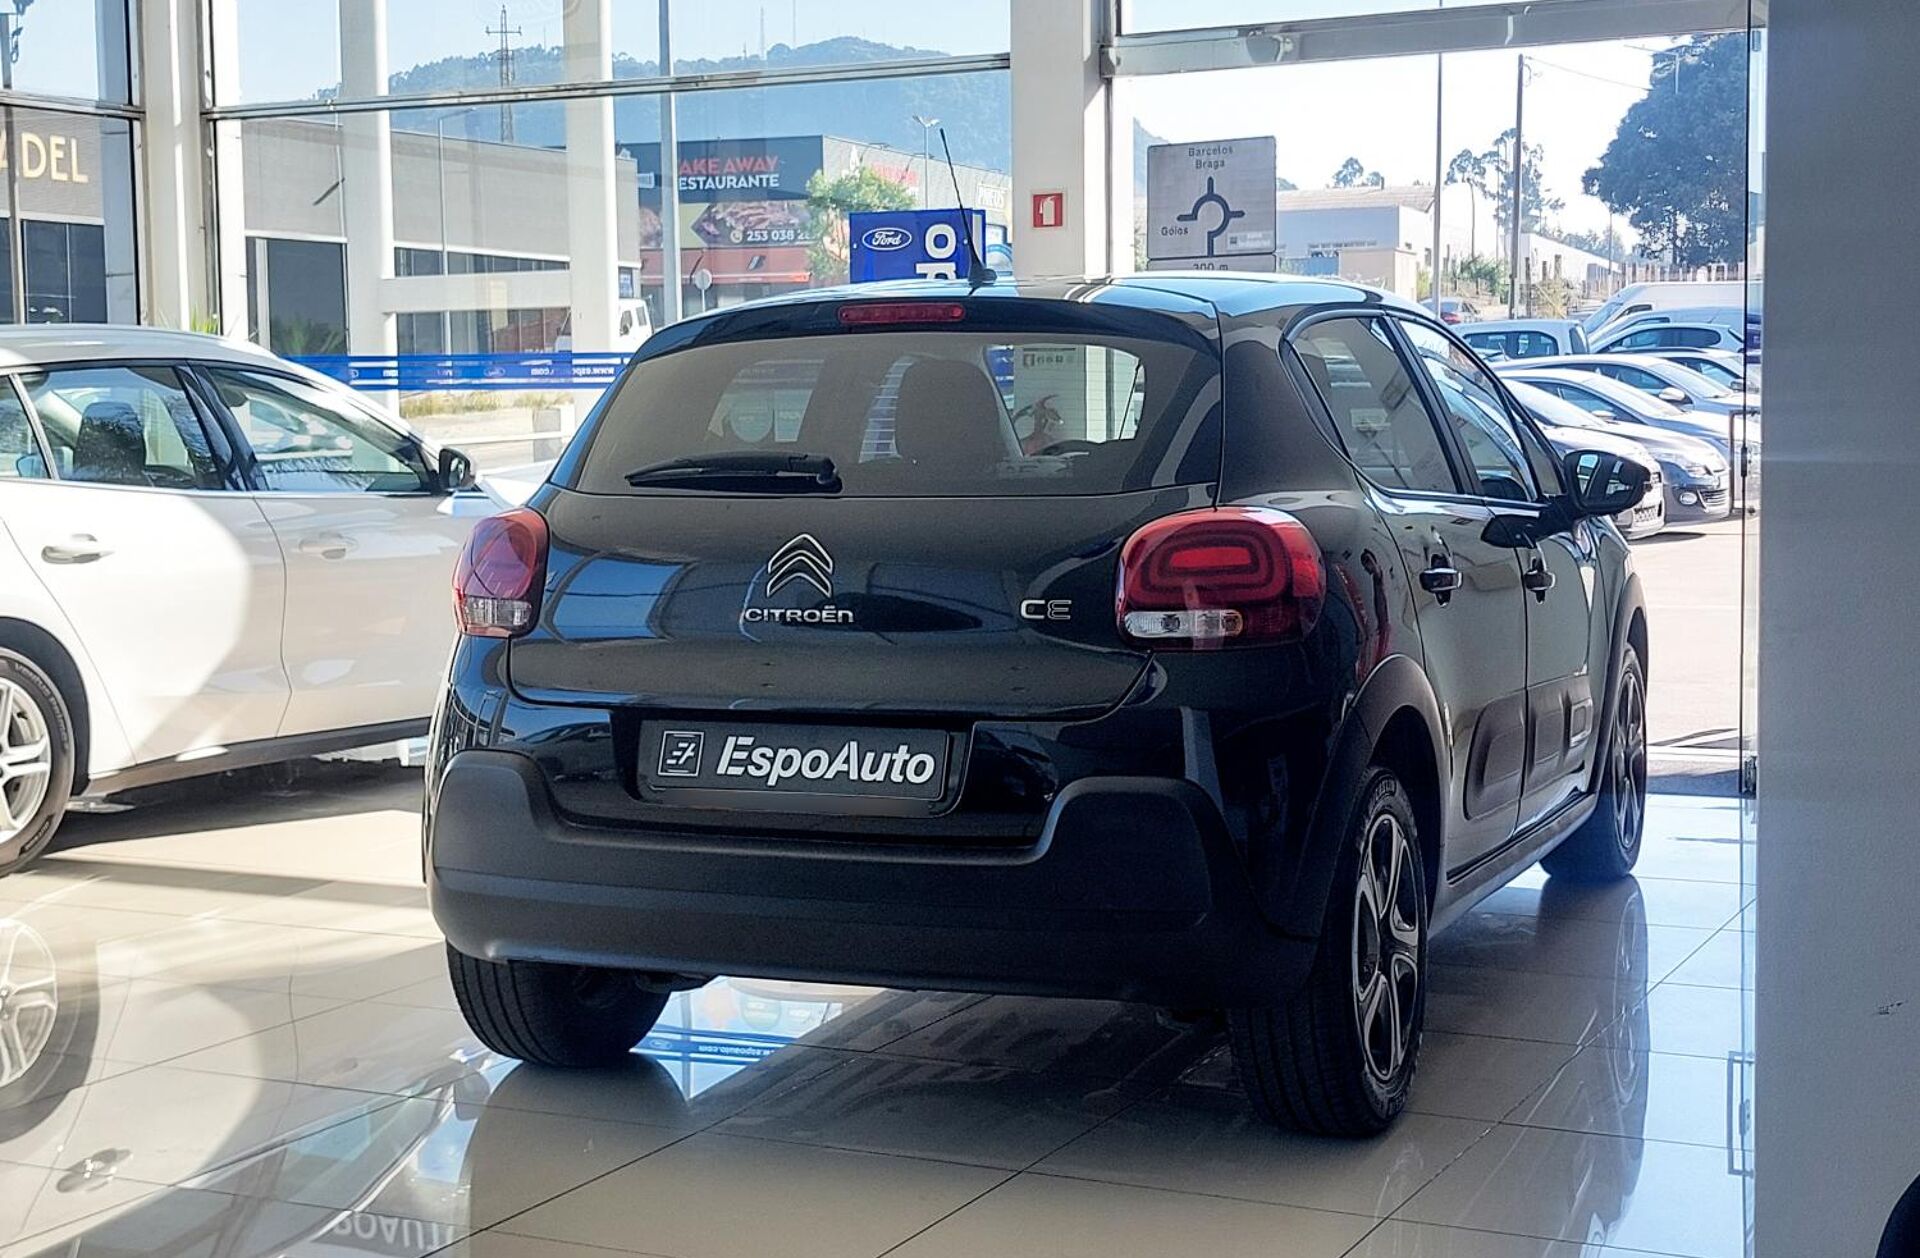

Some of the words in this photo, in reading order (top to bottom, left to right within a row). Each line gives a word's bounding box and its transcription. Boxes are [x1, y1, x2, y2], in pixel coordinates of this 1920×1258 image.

[1188, 145, 1233, 157] Barcelos
[678, 158, 720, 175] AKE
[723, 155, 778, 173] AWAY
[1195, 159, 1225, 170] Braga
[678, 173, 780, 191] ESTAURANTE
[746, 230, 769, 242] 253
[744, 604, 855, 623] CITROËN
[716, 736, 936, 787] EspoAuto
